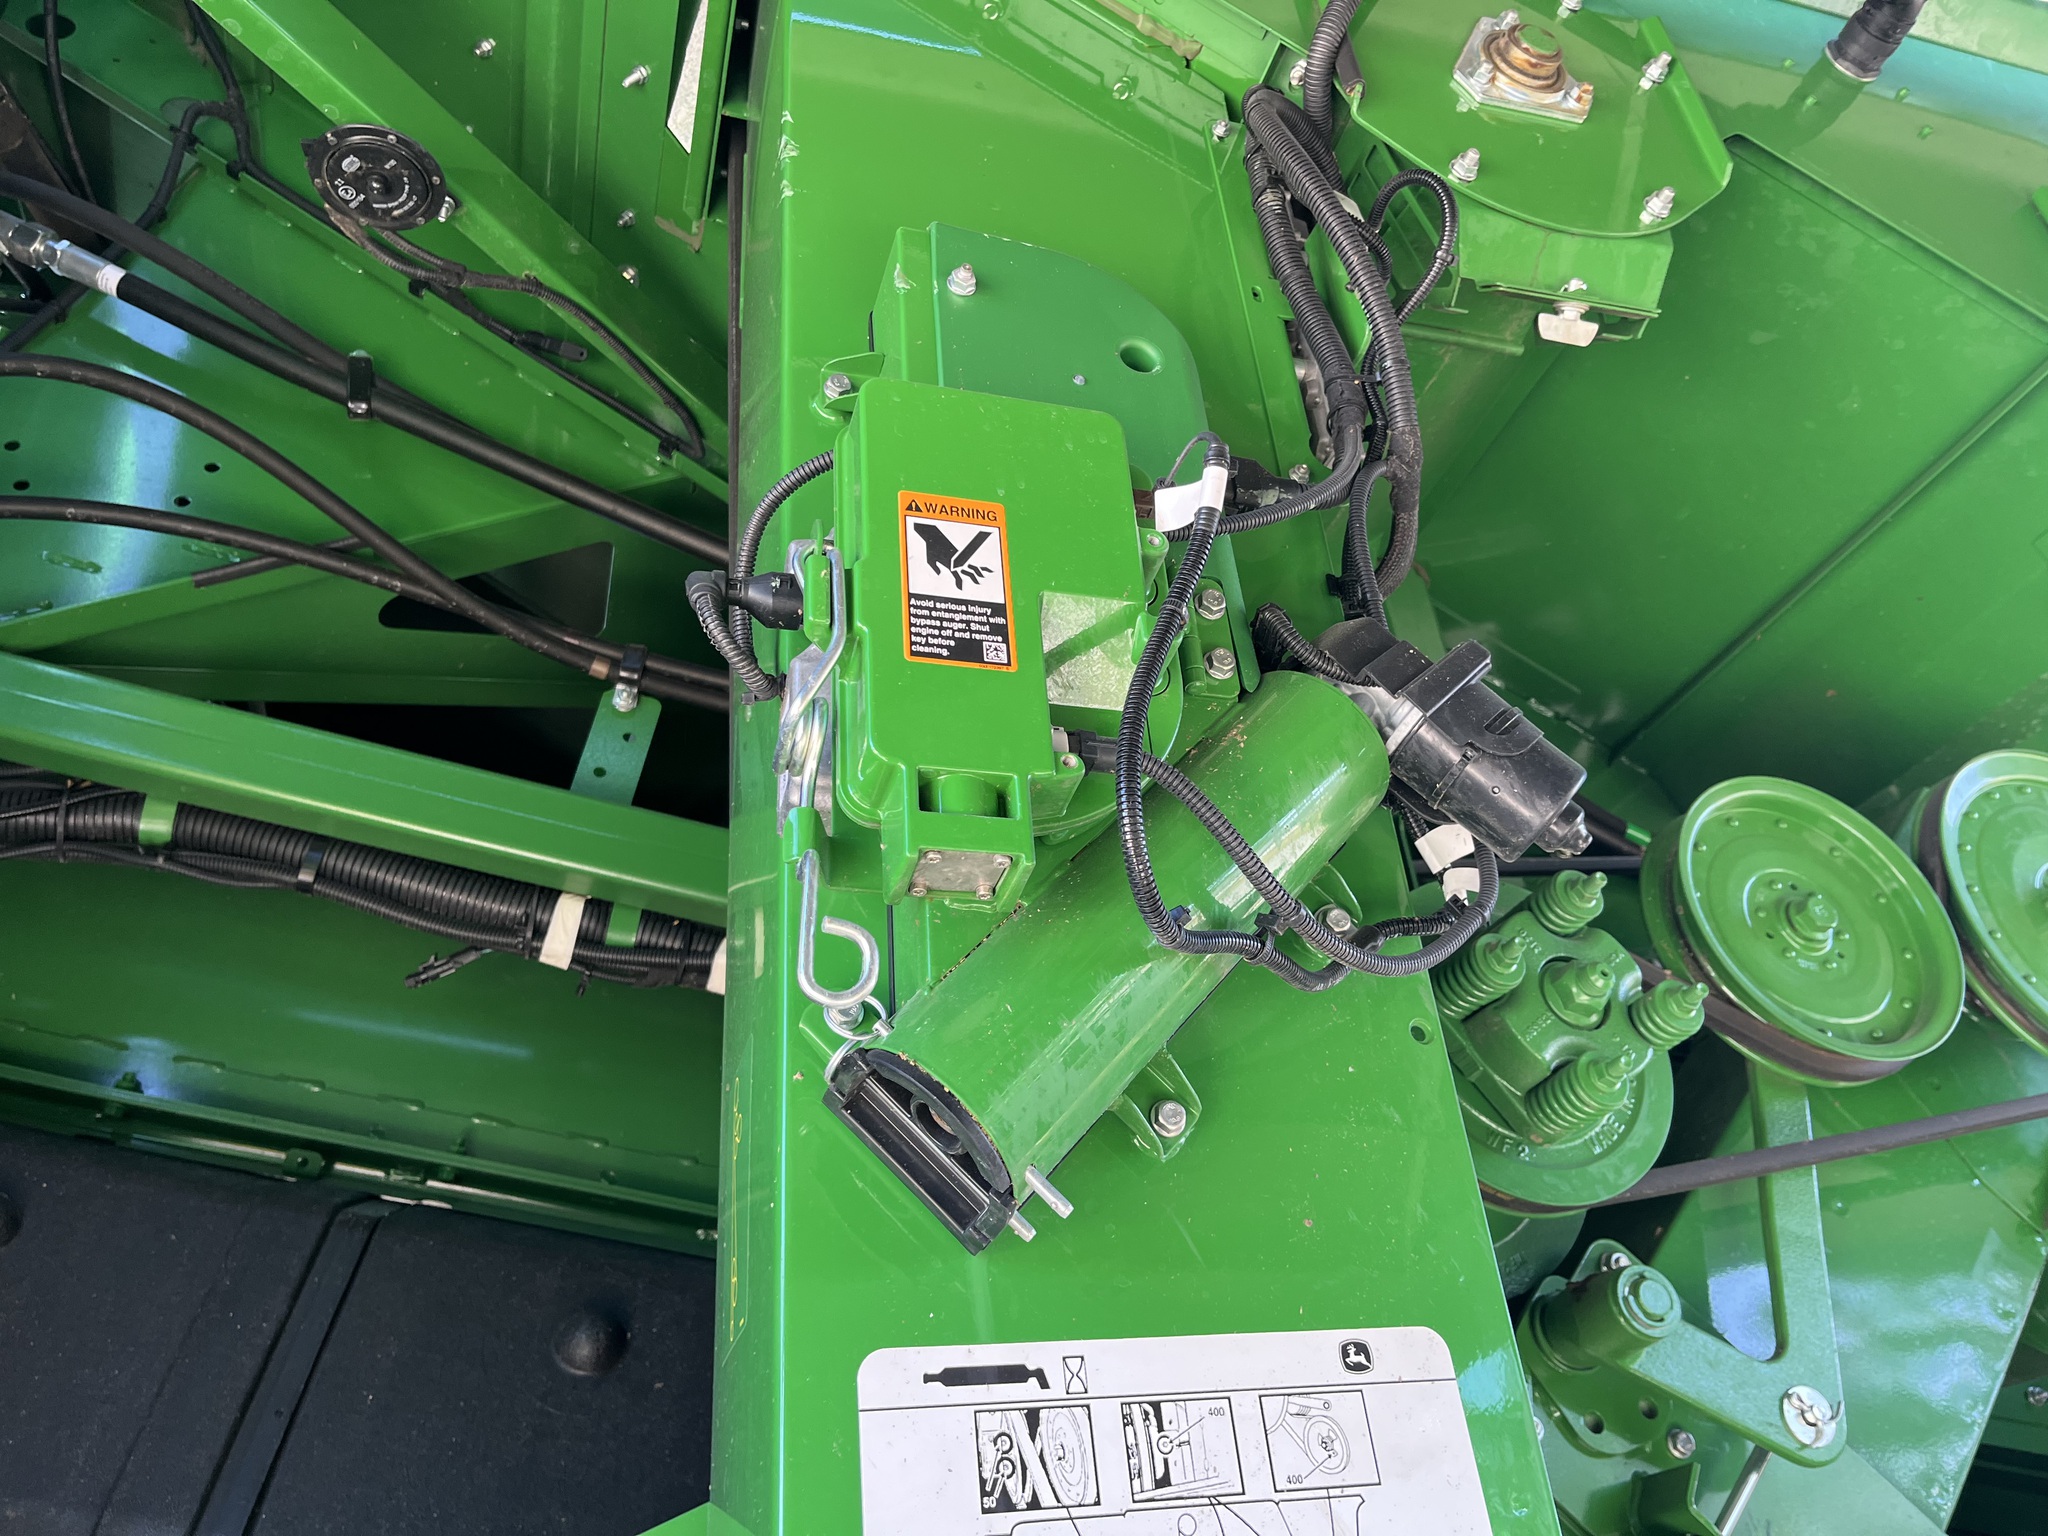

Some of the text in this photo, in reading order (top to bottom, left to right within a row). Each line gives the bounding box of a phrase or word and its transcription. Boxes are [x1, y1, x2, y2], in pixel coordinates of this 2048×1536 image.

[924, 502, 997, 522] WARNING
[910, 598, 991, 615] Avoid serious injury
[910, 607, 930, 616] from
[931, 610, 987, 622] entanglement
[910, 616, 990, 631] bypass auger. Shut
[910, 626, 1002, 642] engine off and remove
[911, 635, 955, 646] key before
[911, 644, 950, 656] cleaning.
[1586, 1111, 1625, 1155] MADE
[1208, 1406, 1225, 1417] 400
[1286, 1474, 1304, 1485] 400
[982, 1497, 996, 1509] 50
